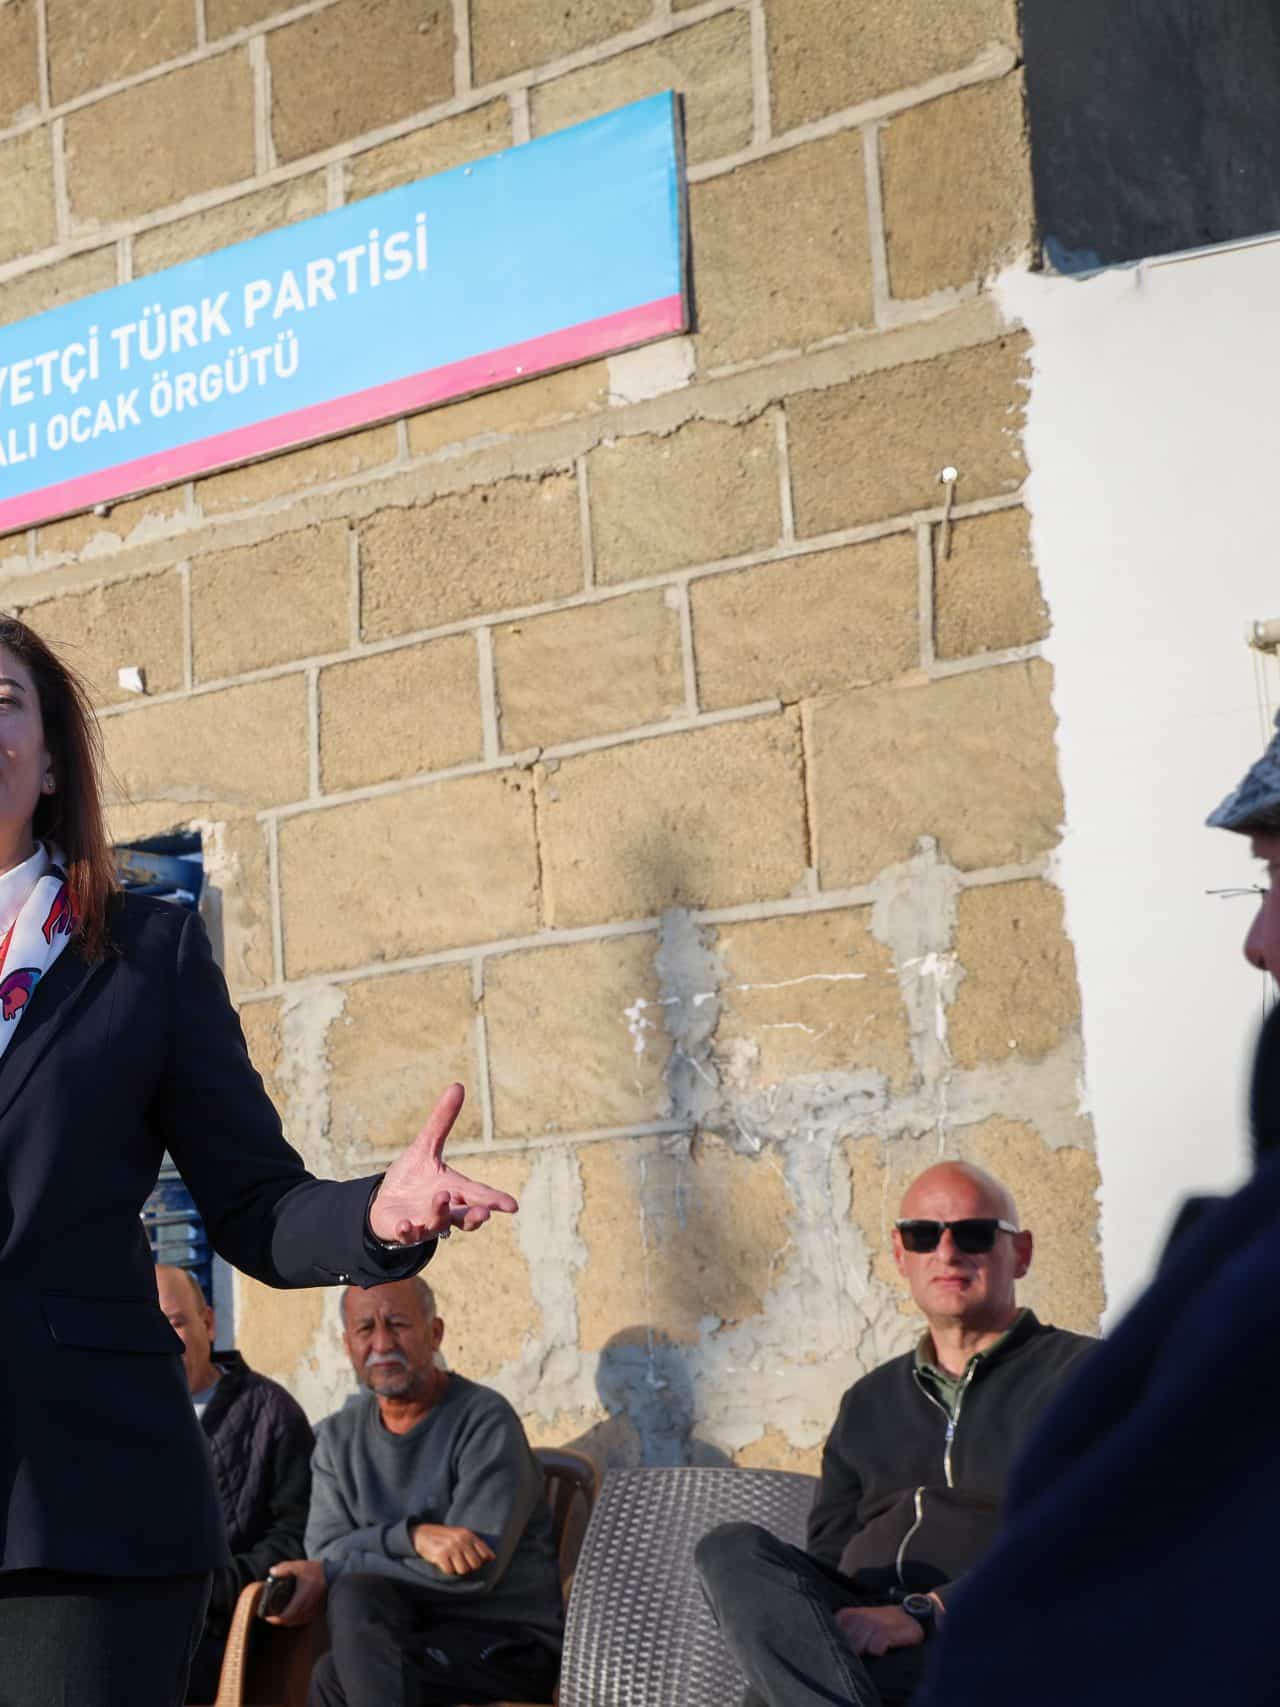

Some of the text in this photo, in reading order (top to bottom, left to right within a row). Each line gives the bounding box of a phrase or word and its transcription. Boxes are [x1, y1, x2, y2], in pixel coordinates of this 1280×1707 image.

[110, 289, 233, 371] TÜRK
[242, 211, 430, 330] PARTİSİ
[45, 386, 143, 452] OCAK
[148, 327, 301, 419] ÖRGÜTÜ
